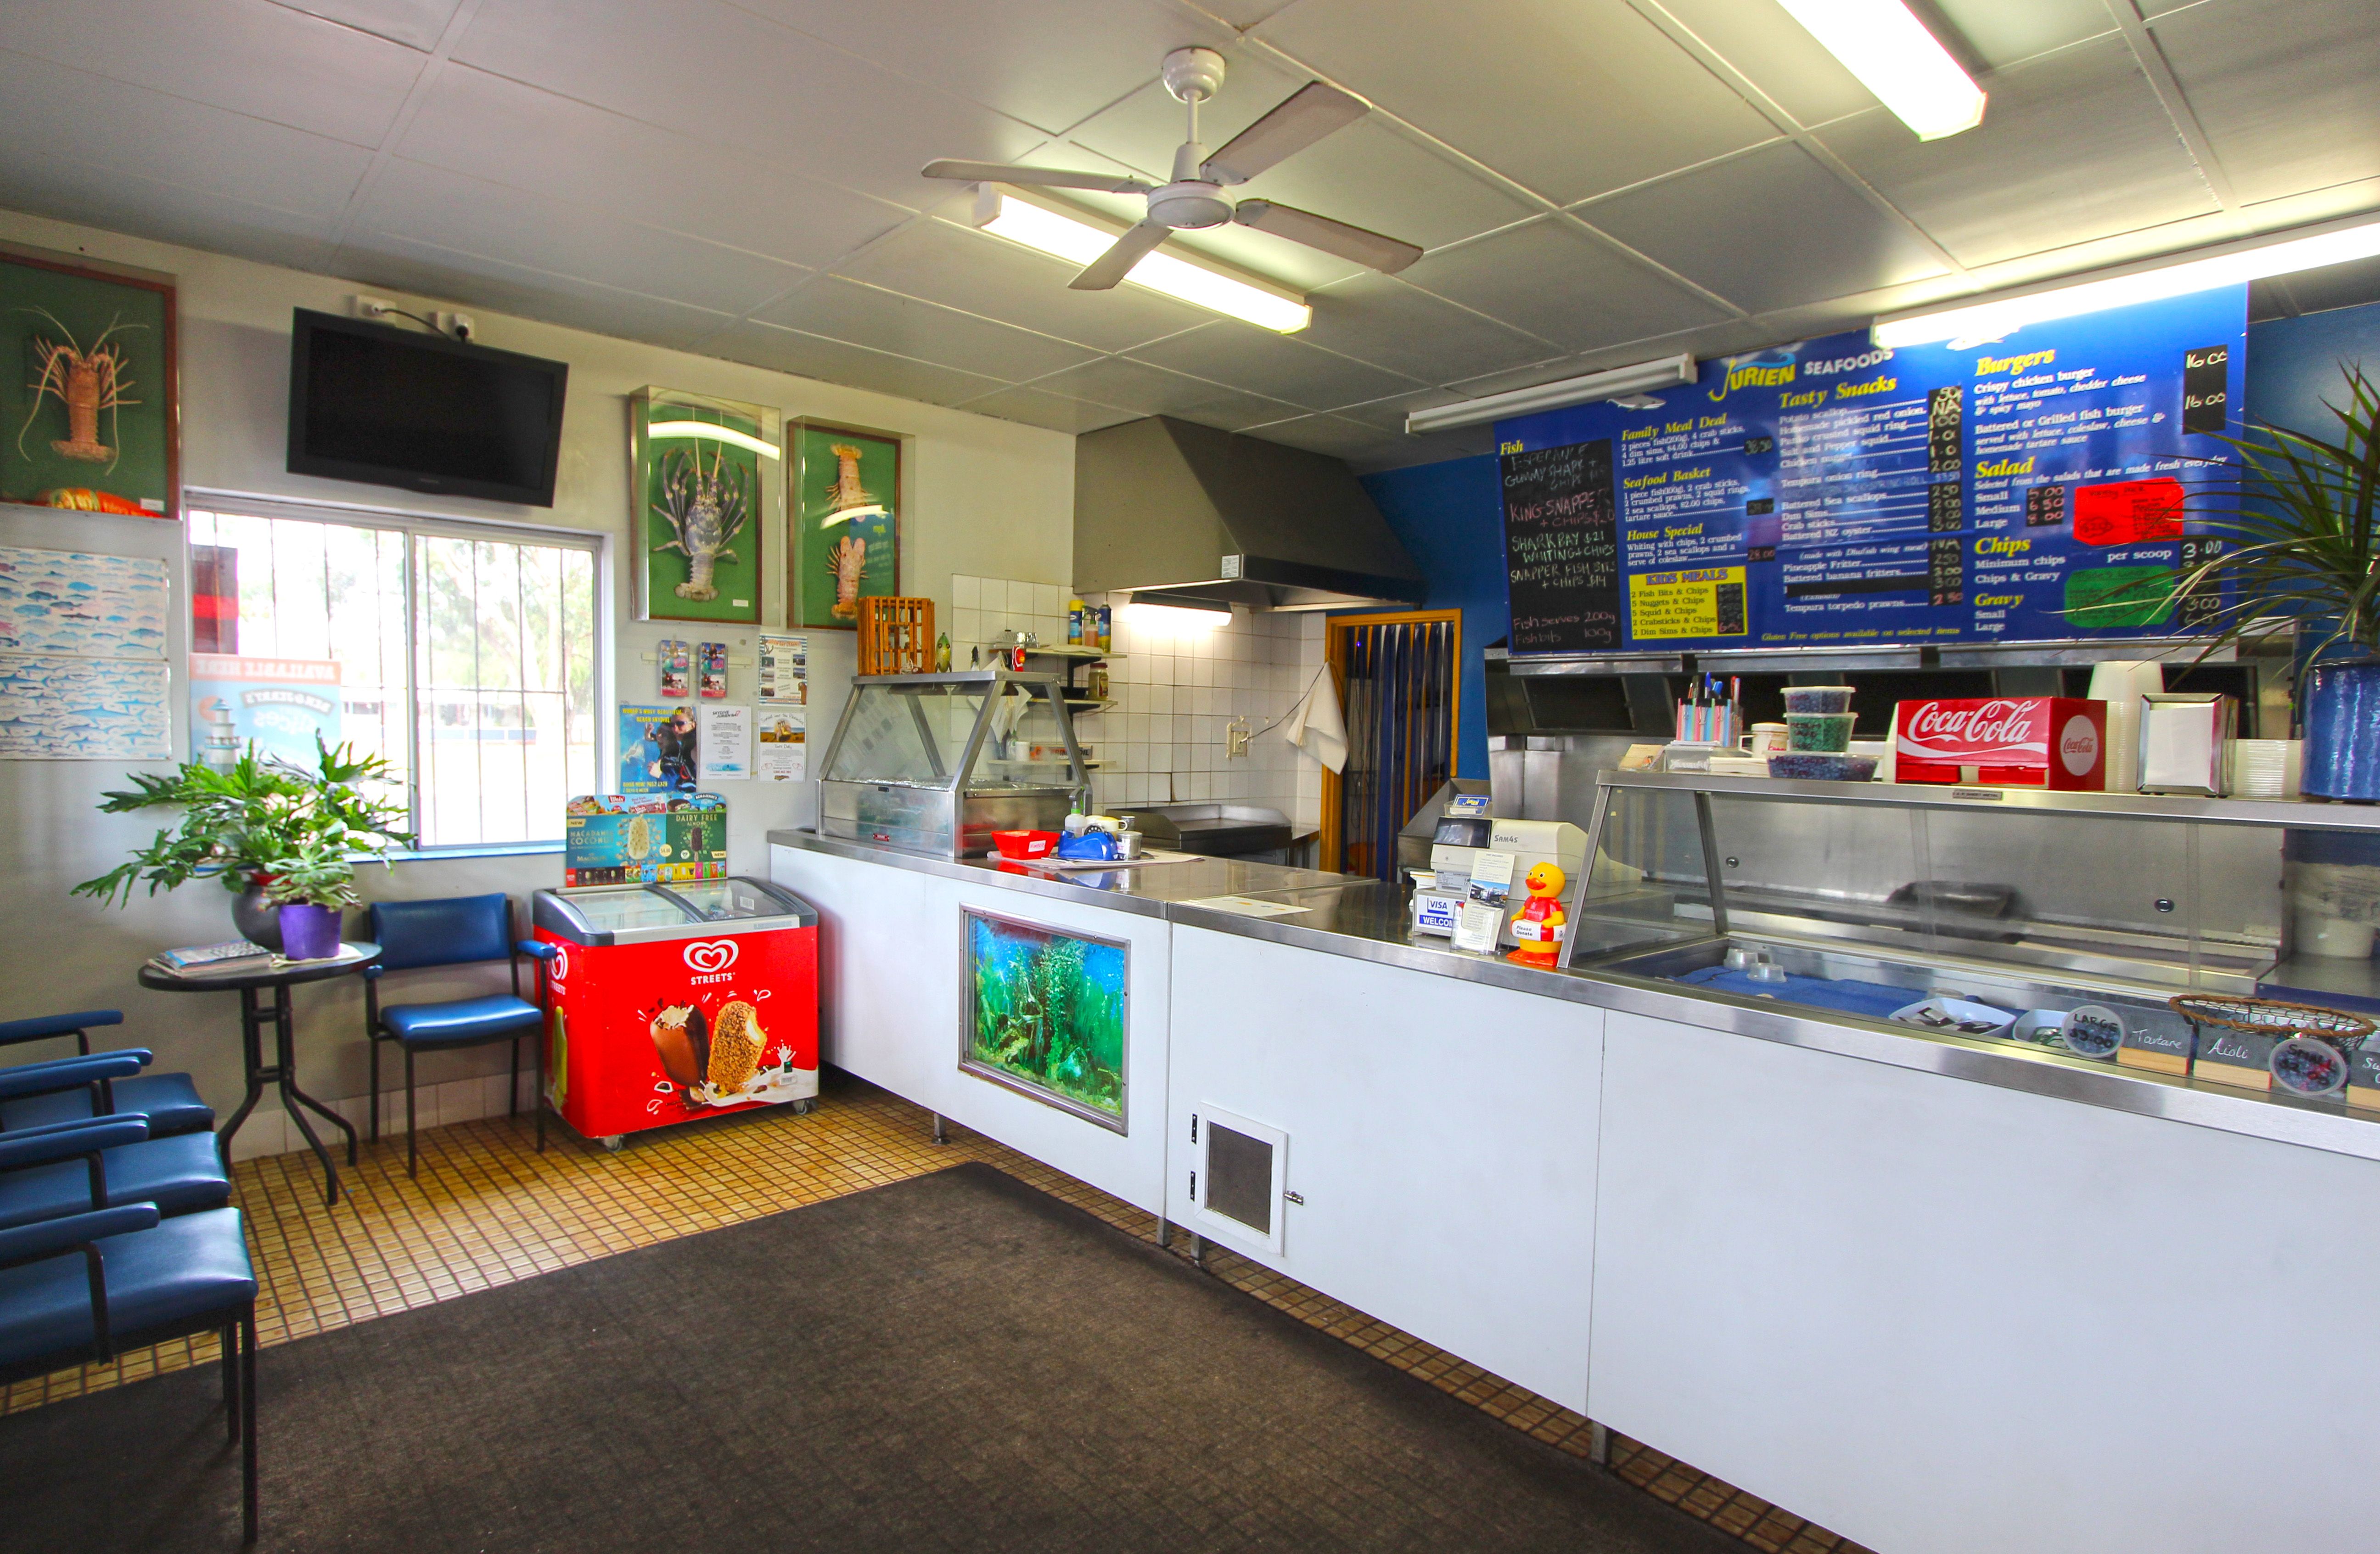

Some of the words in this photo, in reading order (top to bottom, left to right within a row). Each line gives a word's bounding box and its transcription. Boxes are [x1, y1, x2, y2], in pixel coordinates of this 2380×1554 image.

[1975, 349, 2057, 377] Burgers
[1707, 360, 1796, 402] JURIEN
[1804, 349, 1894, 376] SEAFOODS
[1974, 381, 2009, 395] Crispy
[2012, 374, 2054, 388] chicken
[2057, 367, 2095, 383] burger
[1779, 391, 1828, 409] Tasty
[1834, 375, 1897, 400] Snacks
[2032, 386, 2066, 398] tomato,
[2112, 374, 2146, 386] cheese
[1622, 426, 1659, 441] Family
[1665, 419, 1693, 434] Meal
[1700, 413, 1727, 428] Deal
[1975, 421, 2019, 435] Battered
[2038, 413, 2076, 426] Grilled
[2080, 409, 2102, 420] fish
[2106, 404, 2144, 417] burger
[2114, 416, 2149, 428] cheese
[1500, 440, 1523, 455] Fish
[1629, 440, 1651, 451] pieces
[1701, 429, 1717, 438] crab
[1630, 448, 1643, 457] dim
[1690, 438, 1710, 450] chips
[1622, 458, 1636, 467] 1.25
[1639, 455, 1653, 464] litre
[1656, 453, 1669, 462] soft
[1975, 456, 2036, 479] Salad
[2126, 462, 2150, 473] made
[2155, 459, 2181, 471] fresh
[1623, 472, 1667, 489] Seafood
[1673, 467, 1711, 481] Basket
[1631, 490, 1648, 501] piece
[1695, 481, 1712, 490] crab
[1632, 495, 1662, 505] crumbed
[1704, 488, 1724, 498] squid
[1975, 490, 2008, 502] Small
[1626, 513, 1651, 522] tartare
[1975, 504, 2020, 516] Medium
[1975, 518, 2008, 529] Large
[1627, 529, 1659, 541] House
[1665, 523, 1704, 540] Special
[1512, 533, 1555, 551] SHARK
[1558, 532, 1579, 547] BAY
[1628, 542, 1655, 551] Whiting
[1658, 539, 1673, 547] with
[1677, 537, 1698, 546] chips,
[1707, 534, 1742, 542] crumbed
[1975, 536, 2031, 557] Chips
[1523, 549, 1576, 563] WHITING
[1628, 551, 1653, 560] prawns,
[1680, 546, 1710, 554] scallops
[1975, 558, 2029, 570] Minimum
[2034, 555, 2066, 567] chips
[2107, 552, 2128, 563] per
[2133, 549, 2172, 560] scoop
[1566, 561, 1589, 574] FISH
[1783, 562, 1827, 572] Pineapple
[1646, 573, 1678, 585] KIDS
[1682, 569, 1728, 582] MEALS
[1783, 574, 1822, 583] Battered
[1975, 573, 2007, 585] Chips
[2025, 570, 2060, 583] Gravy
[1686, 586, 1709, 595] Chips
[1640, 598, 1670, 607] Nuggets
[1683, 597, 1705, 605] Chips
[1785, 602, 1824, 613] Tempura
[1828, 600, 1865, 611] torpedo
[1975, 593, 2024, 608] Gravy
[1640, 608, 1662, 618] Squid
[1976, 609, 2006, 619] Small
[1514, 616, 1538, 630] Fish
[1640, 618, 1680, 626] Crabsticks
[1975, 622, 2005, 632] Large
[1908, 700, 2041, 743] Coca-Cola
[2063, 737, 2094, 754] Coca-Cola
[1430, 901, 1448, 909] VISA
[690, 973, 734, 985] STREETS
[2074, 1013, 2118, 1032] LARGE
[2133, 1030, 2183, 1050] Tartare
[2208, 1038, 2248, 1059] Aioli
